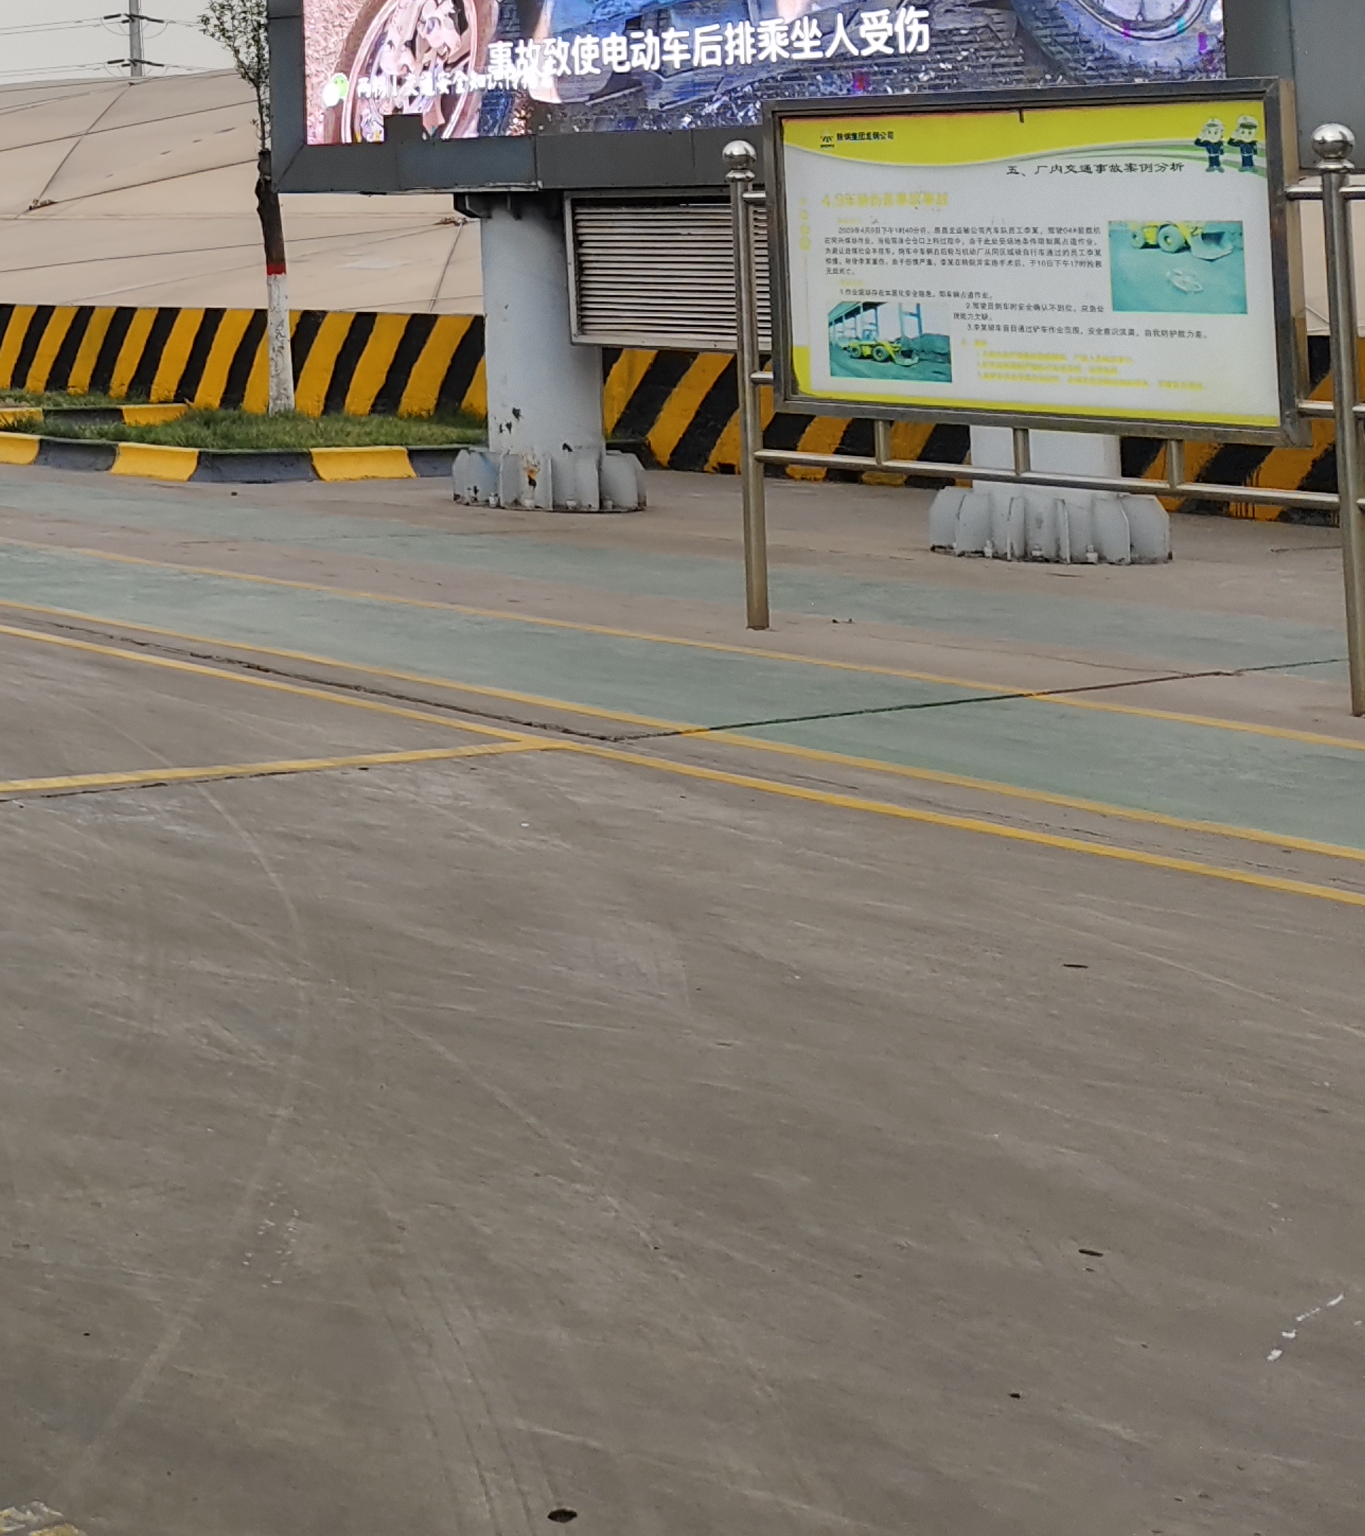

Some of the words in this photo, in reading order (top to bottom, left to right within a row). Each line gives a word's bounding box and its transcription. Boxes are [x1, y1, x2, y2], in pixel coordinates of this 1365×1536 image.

[488, 6, 930, 78] 事故致使电动车后排乘坐人受伤
